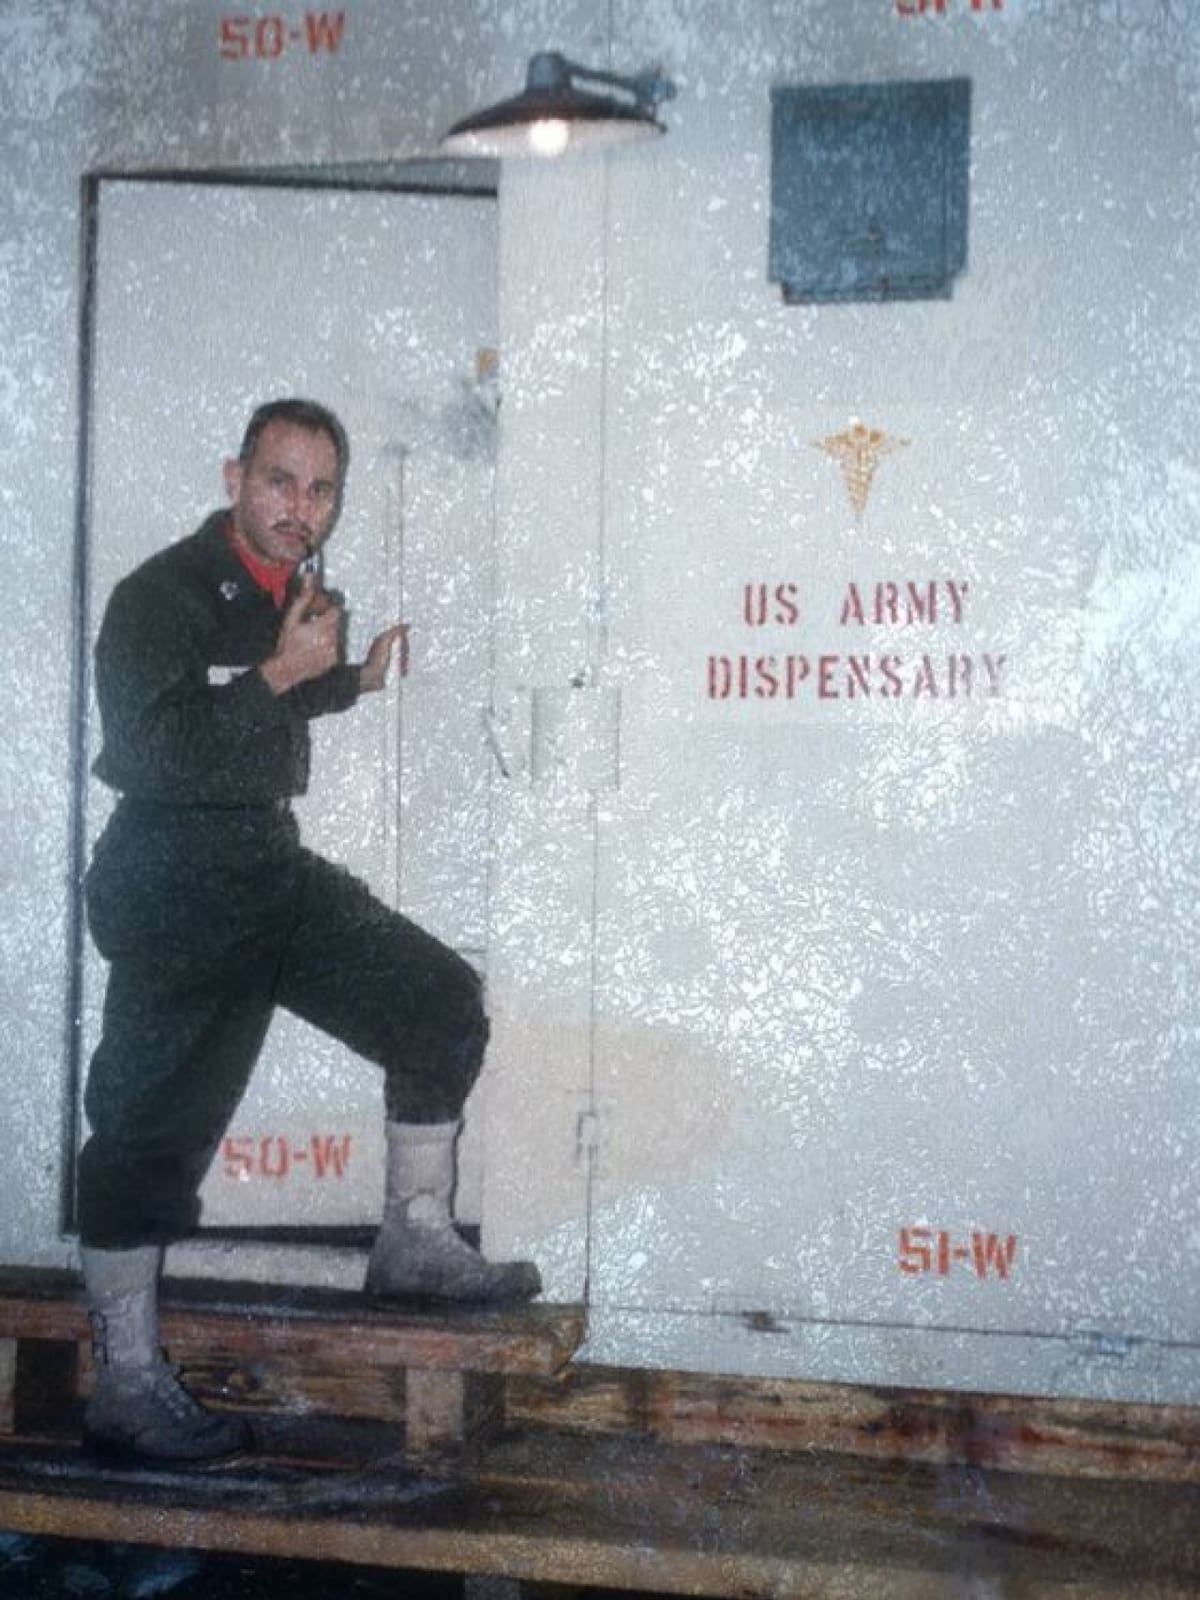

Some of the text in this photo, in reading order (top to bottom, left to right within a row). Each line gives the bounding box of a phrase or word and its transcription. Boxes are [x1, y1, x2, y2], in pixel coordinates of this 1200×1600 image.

[220, 11, 345, 61] 50-W
[744, 579, 969, 625] US ARMY
[708, 653, 1006, 700] DISPENSARY
